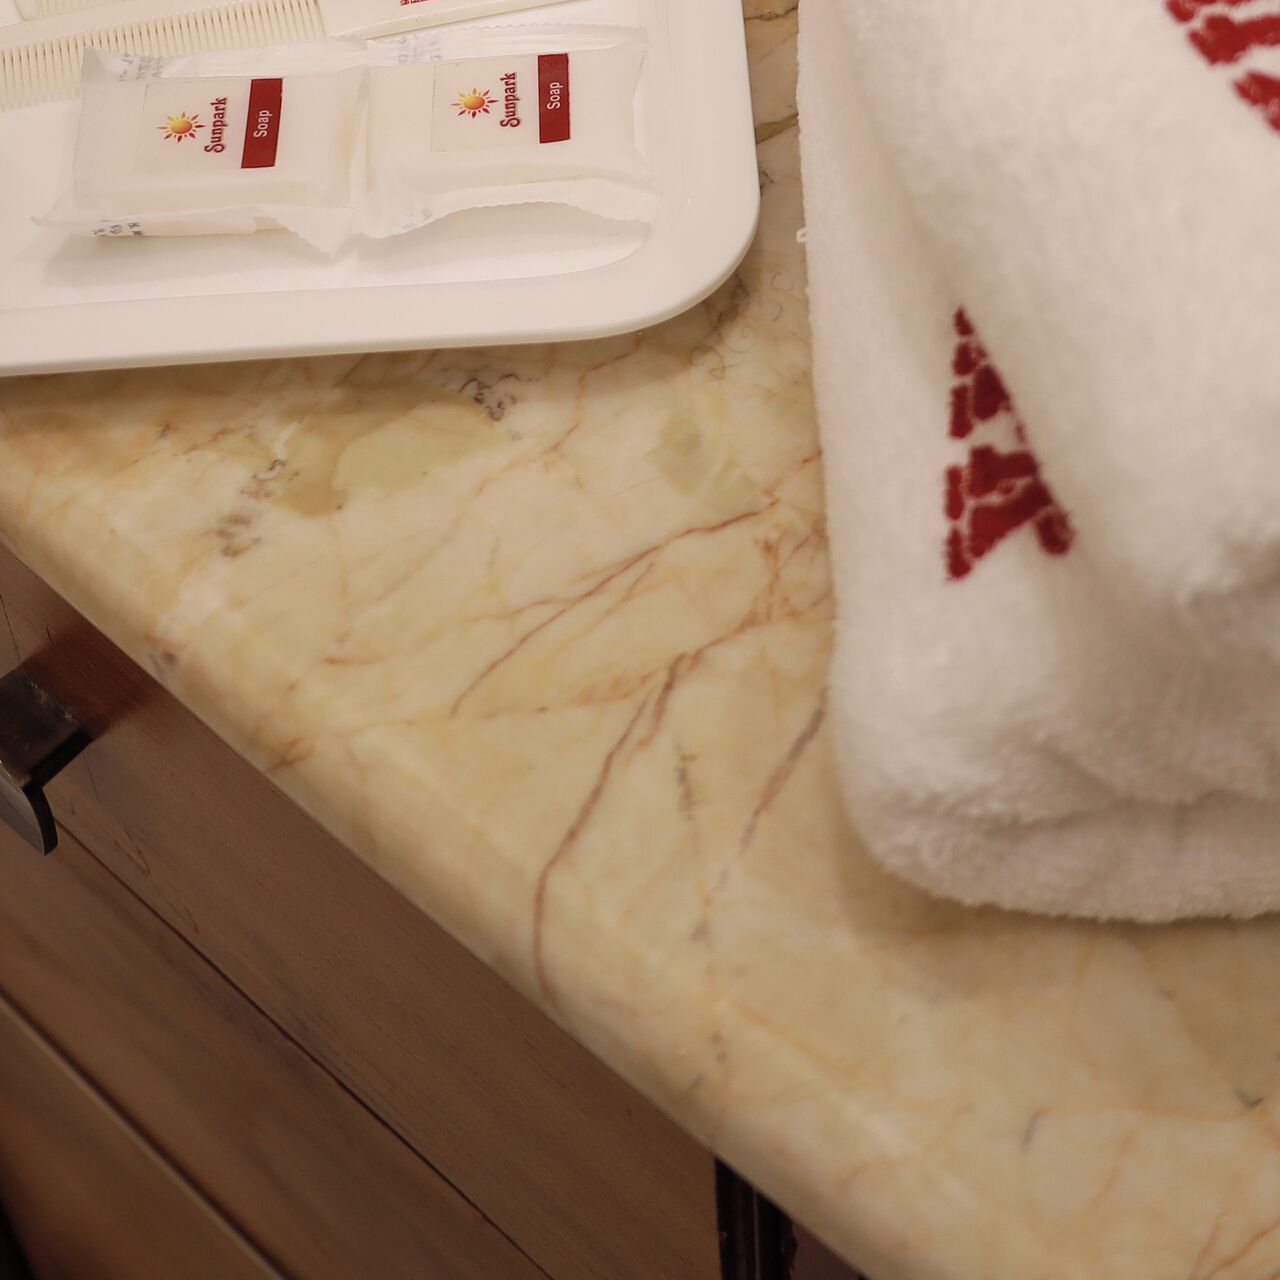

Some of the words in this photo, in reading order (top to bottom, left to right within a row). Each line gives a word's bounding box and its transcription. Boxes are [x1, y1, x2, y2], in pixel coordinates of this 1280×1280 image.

[500, 71, 521, 127] Sunpark
[546, 82, 564, 110] Soap
[204, 97, 229, 153] Sunpark
[253, 109, 273, 138] Soap
